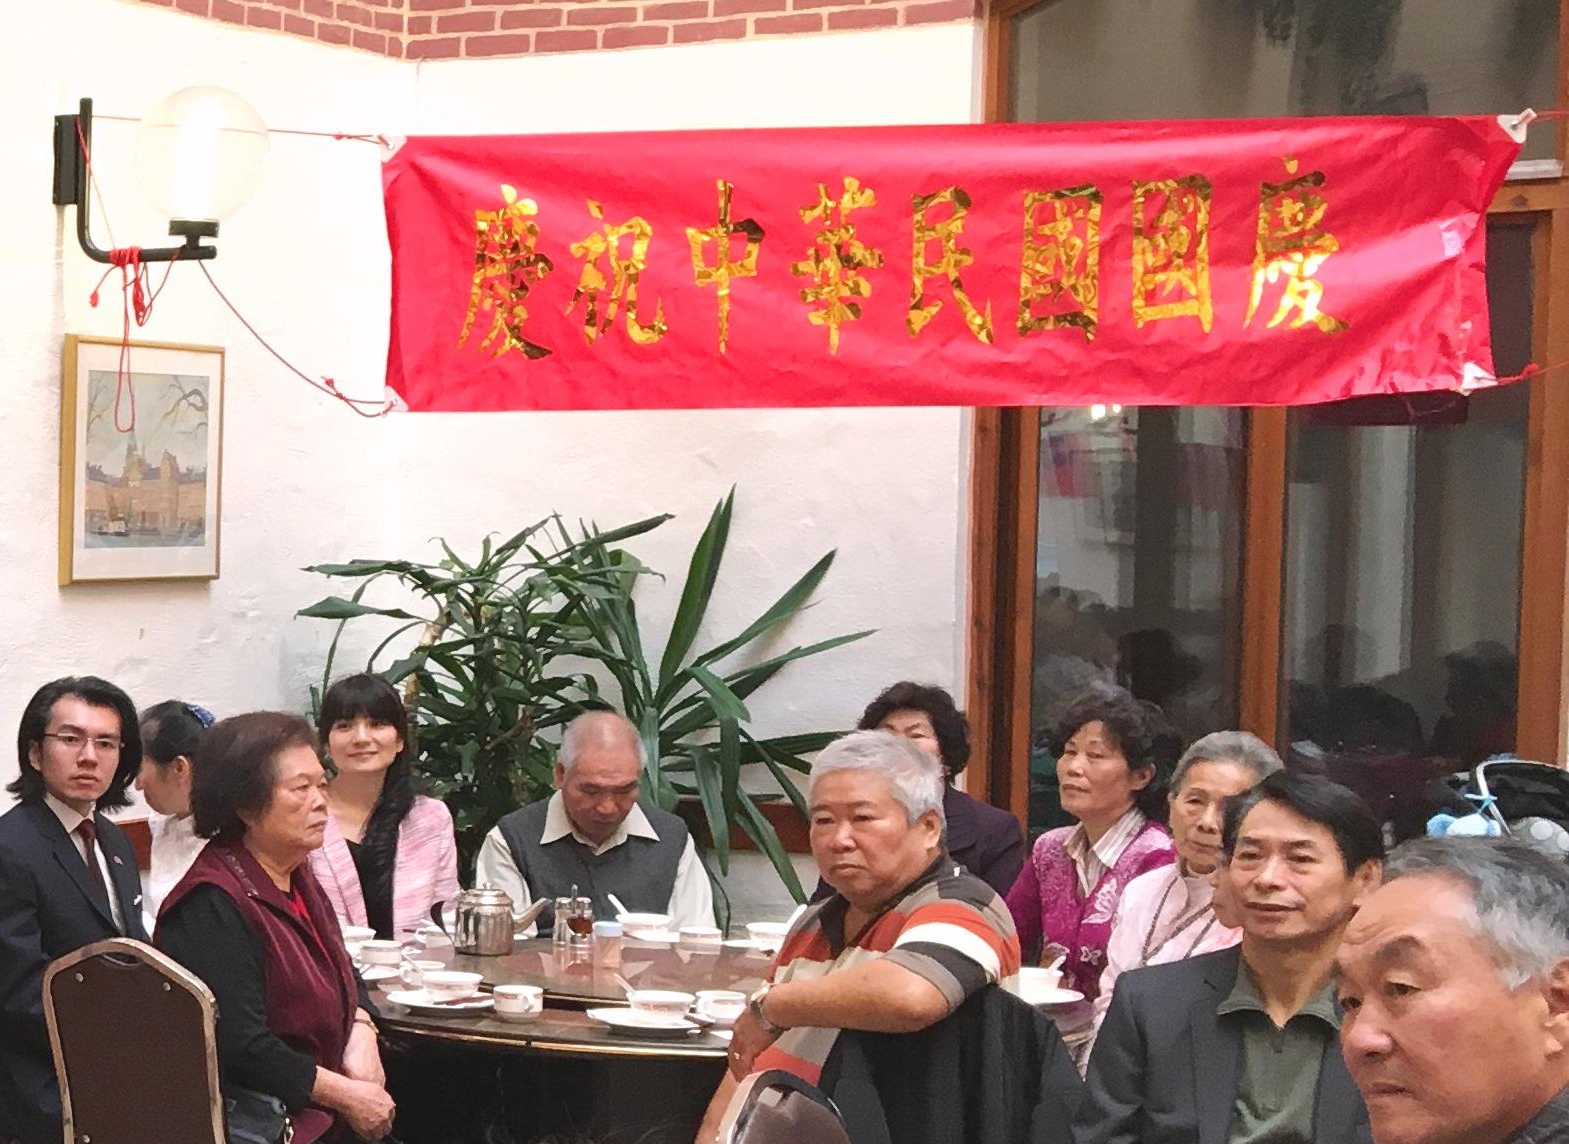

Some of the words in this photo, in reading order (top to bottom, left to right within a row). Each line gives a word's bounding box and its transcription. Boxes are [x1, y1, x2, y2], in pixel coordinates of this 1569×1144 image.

[457, 156, 1349, 359] 慶祝中華民國國慶
